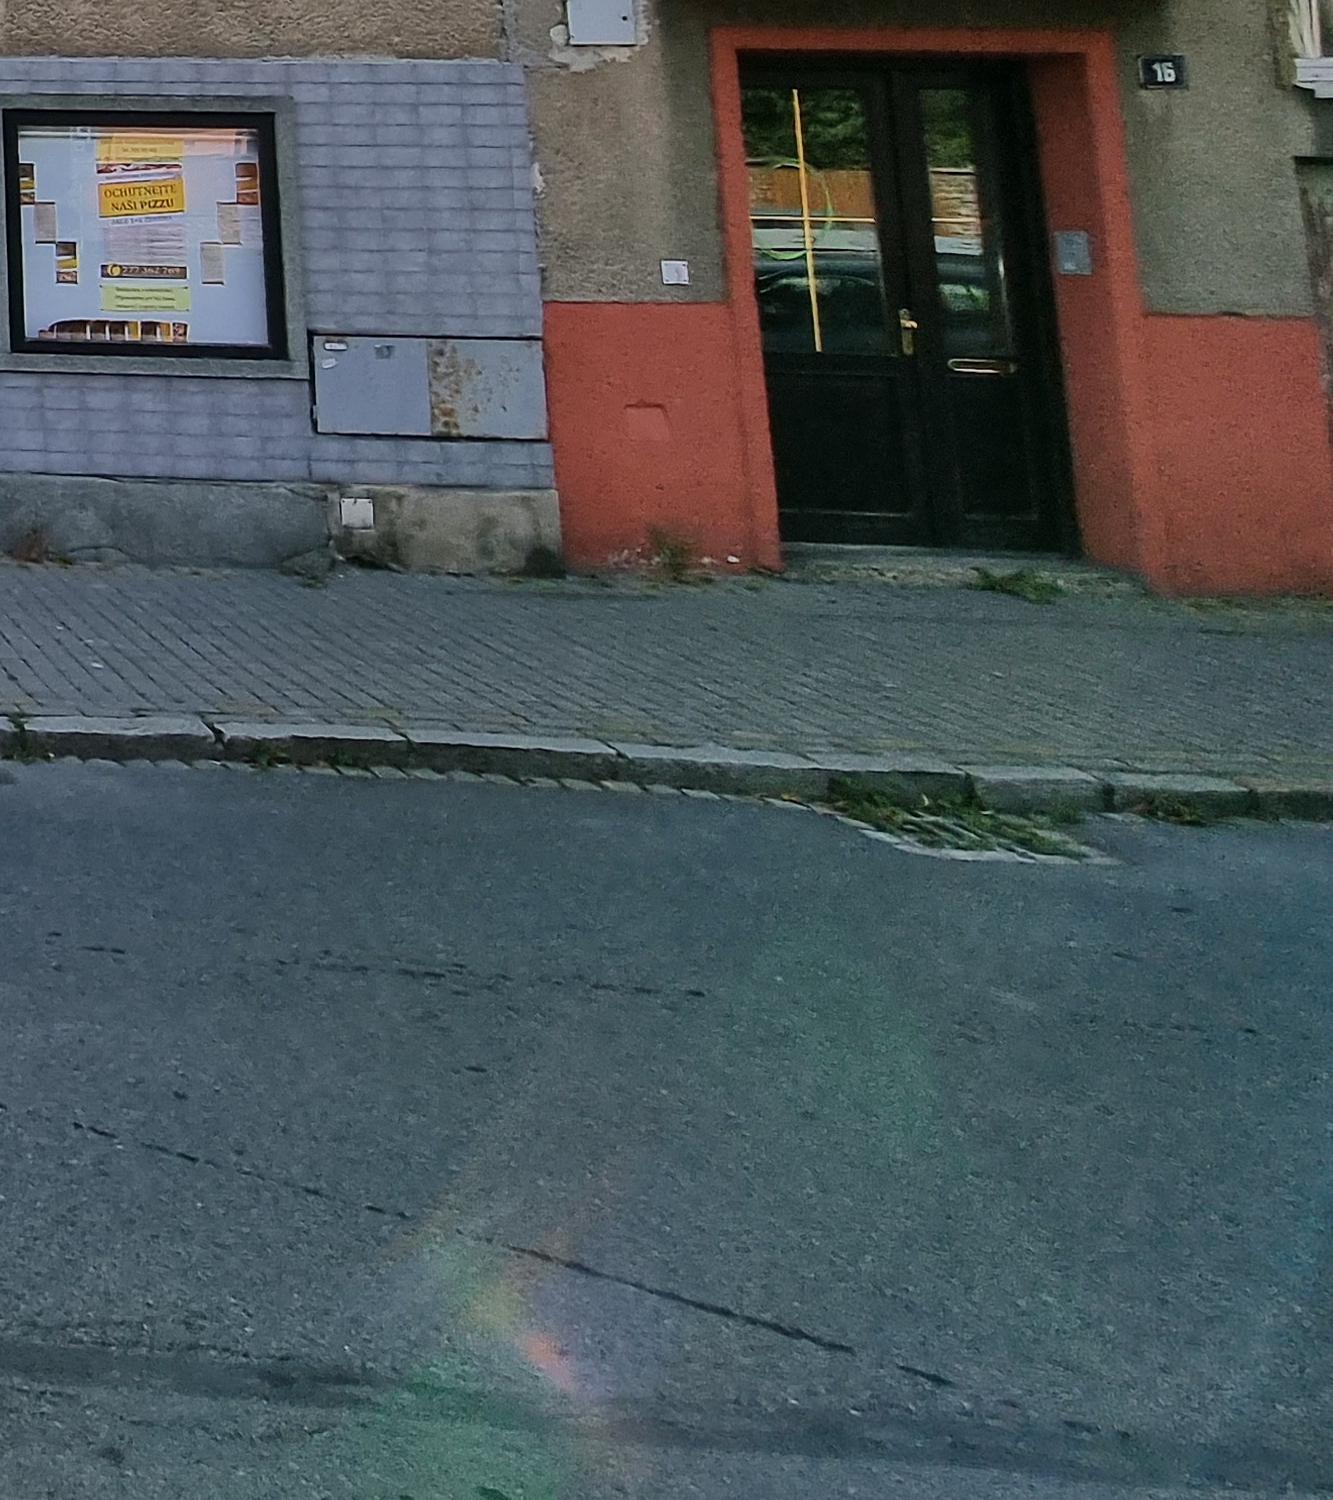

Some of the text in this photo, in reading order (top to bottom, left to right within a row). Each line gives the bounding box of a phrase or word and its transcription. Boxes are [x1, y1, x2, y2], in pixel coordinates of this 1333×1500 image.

[1152, 62, 1176, 82] 16
[104, 184, 177, 198] OCHUTNEJTE
[111, 198, 175, 212] NAŠI PIZZU
